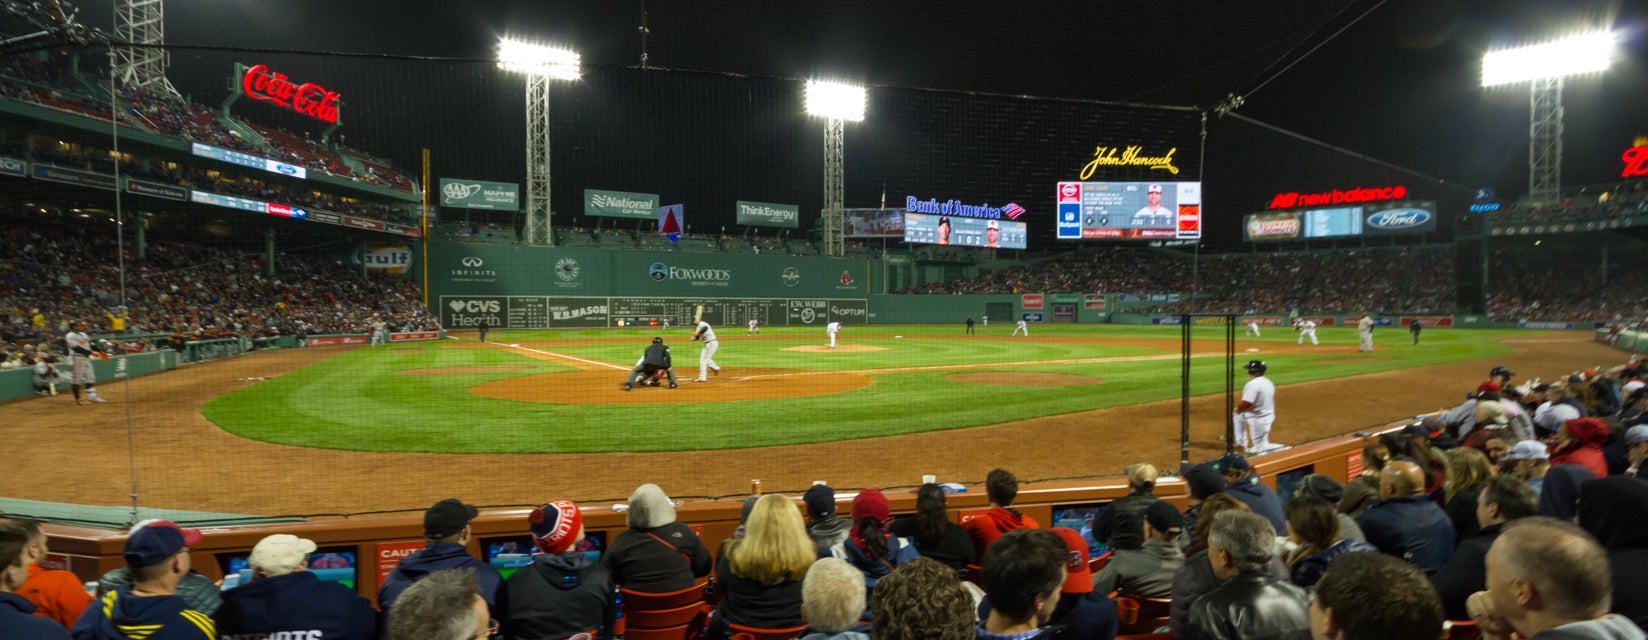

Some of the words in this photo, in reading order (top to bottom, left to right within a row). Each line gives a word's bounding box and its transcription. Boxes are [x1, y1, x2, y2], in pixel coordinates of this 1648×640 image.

[243, 64, 341, 123] Coca-Cola
[1079, 146, 1119, 180] John
[1119, 145, 1179, 174] Hancock
[1332, 186, 1406, 204] balance
[606, 196, 653, 210] National
[907, 195, 940, 215] Bank
[940, 200, 953, 215] of
[953, 201, 1001, 219] America
[741, 205, 793, 220] ThinkEnergy
[1379, 211, 1418, 227] Ford
[669, 266, 730, 281] FOXWOODS
[466, 300, 500, 313] CVS
[839, 308, 865, 316] OPTUM
[451, 313, 500, 326] Heath
